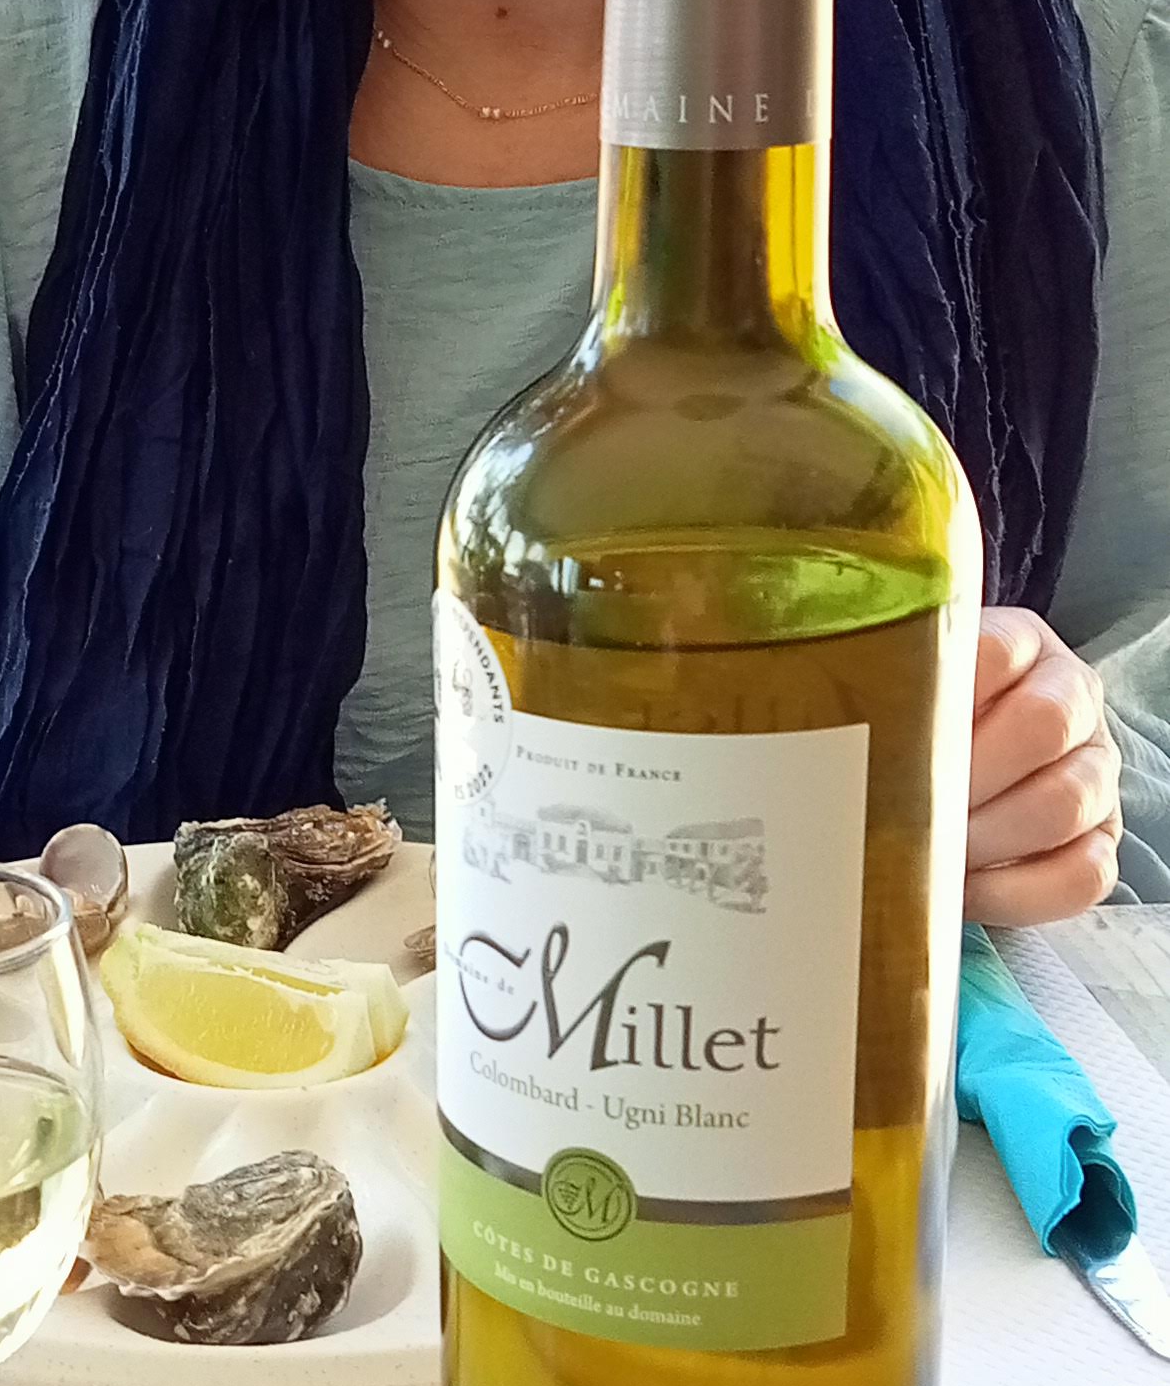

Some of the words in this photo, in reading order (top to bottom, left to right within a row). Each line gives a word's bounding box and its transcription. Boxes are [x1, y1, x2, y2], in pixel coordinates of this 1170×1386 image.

[615, 762, 682, 782] FRANCE
[459, 922, 781, 1072] Millet
[470, 1050, 581, 1112] Colombard
[603, 1094, 665, 1131] Ugni
[675, 1103, 751, 1130] Blanc
[472, 1219, 534, 1264] CÔTES
[543, 1254, 574, 1278] DE
[585, 1267, 741, 1299] GASCOGNE
[537, 1280, 603, 1315] bouteille
[605, 1302, 626, 1319] au
[628, 1304, 703, 1327] domaine
